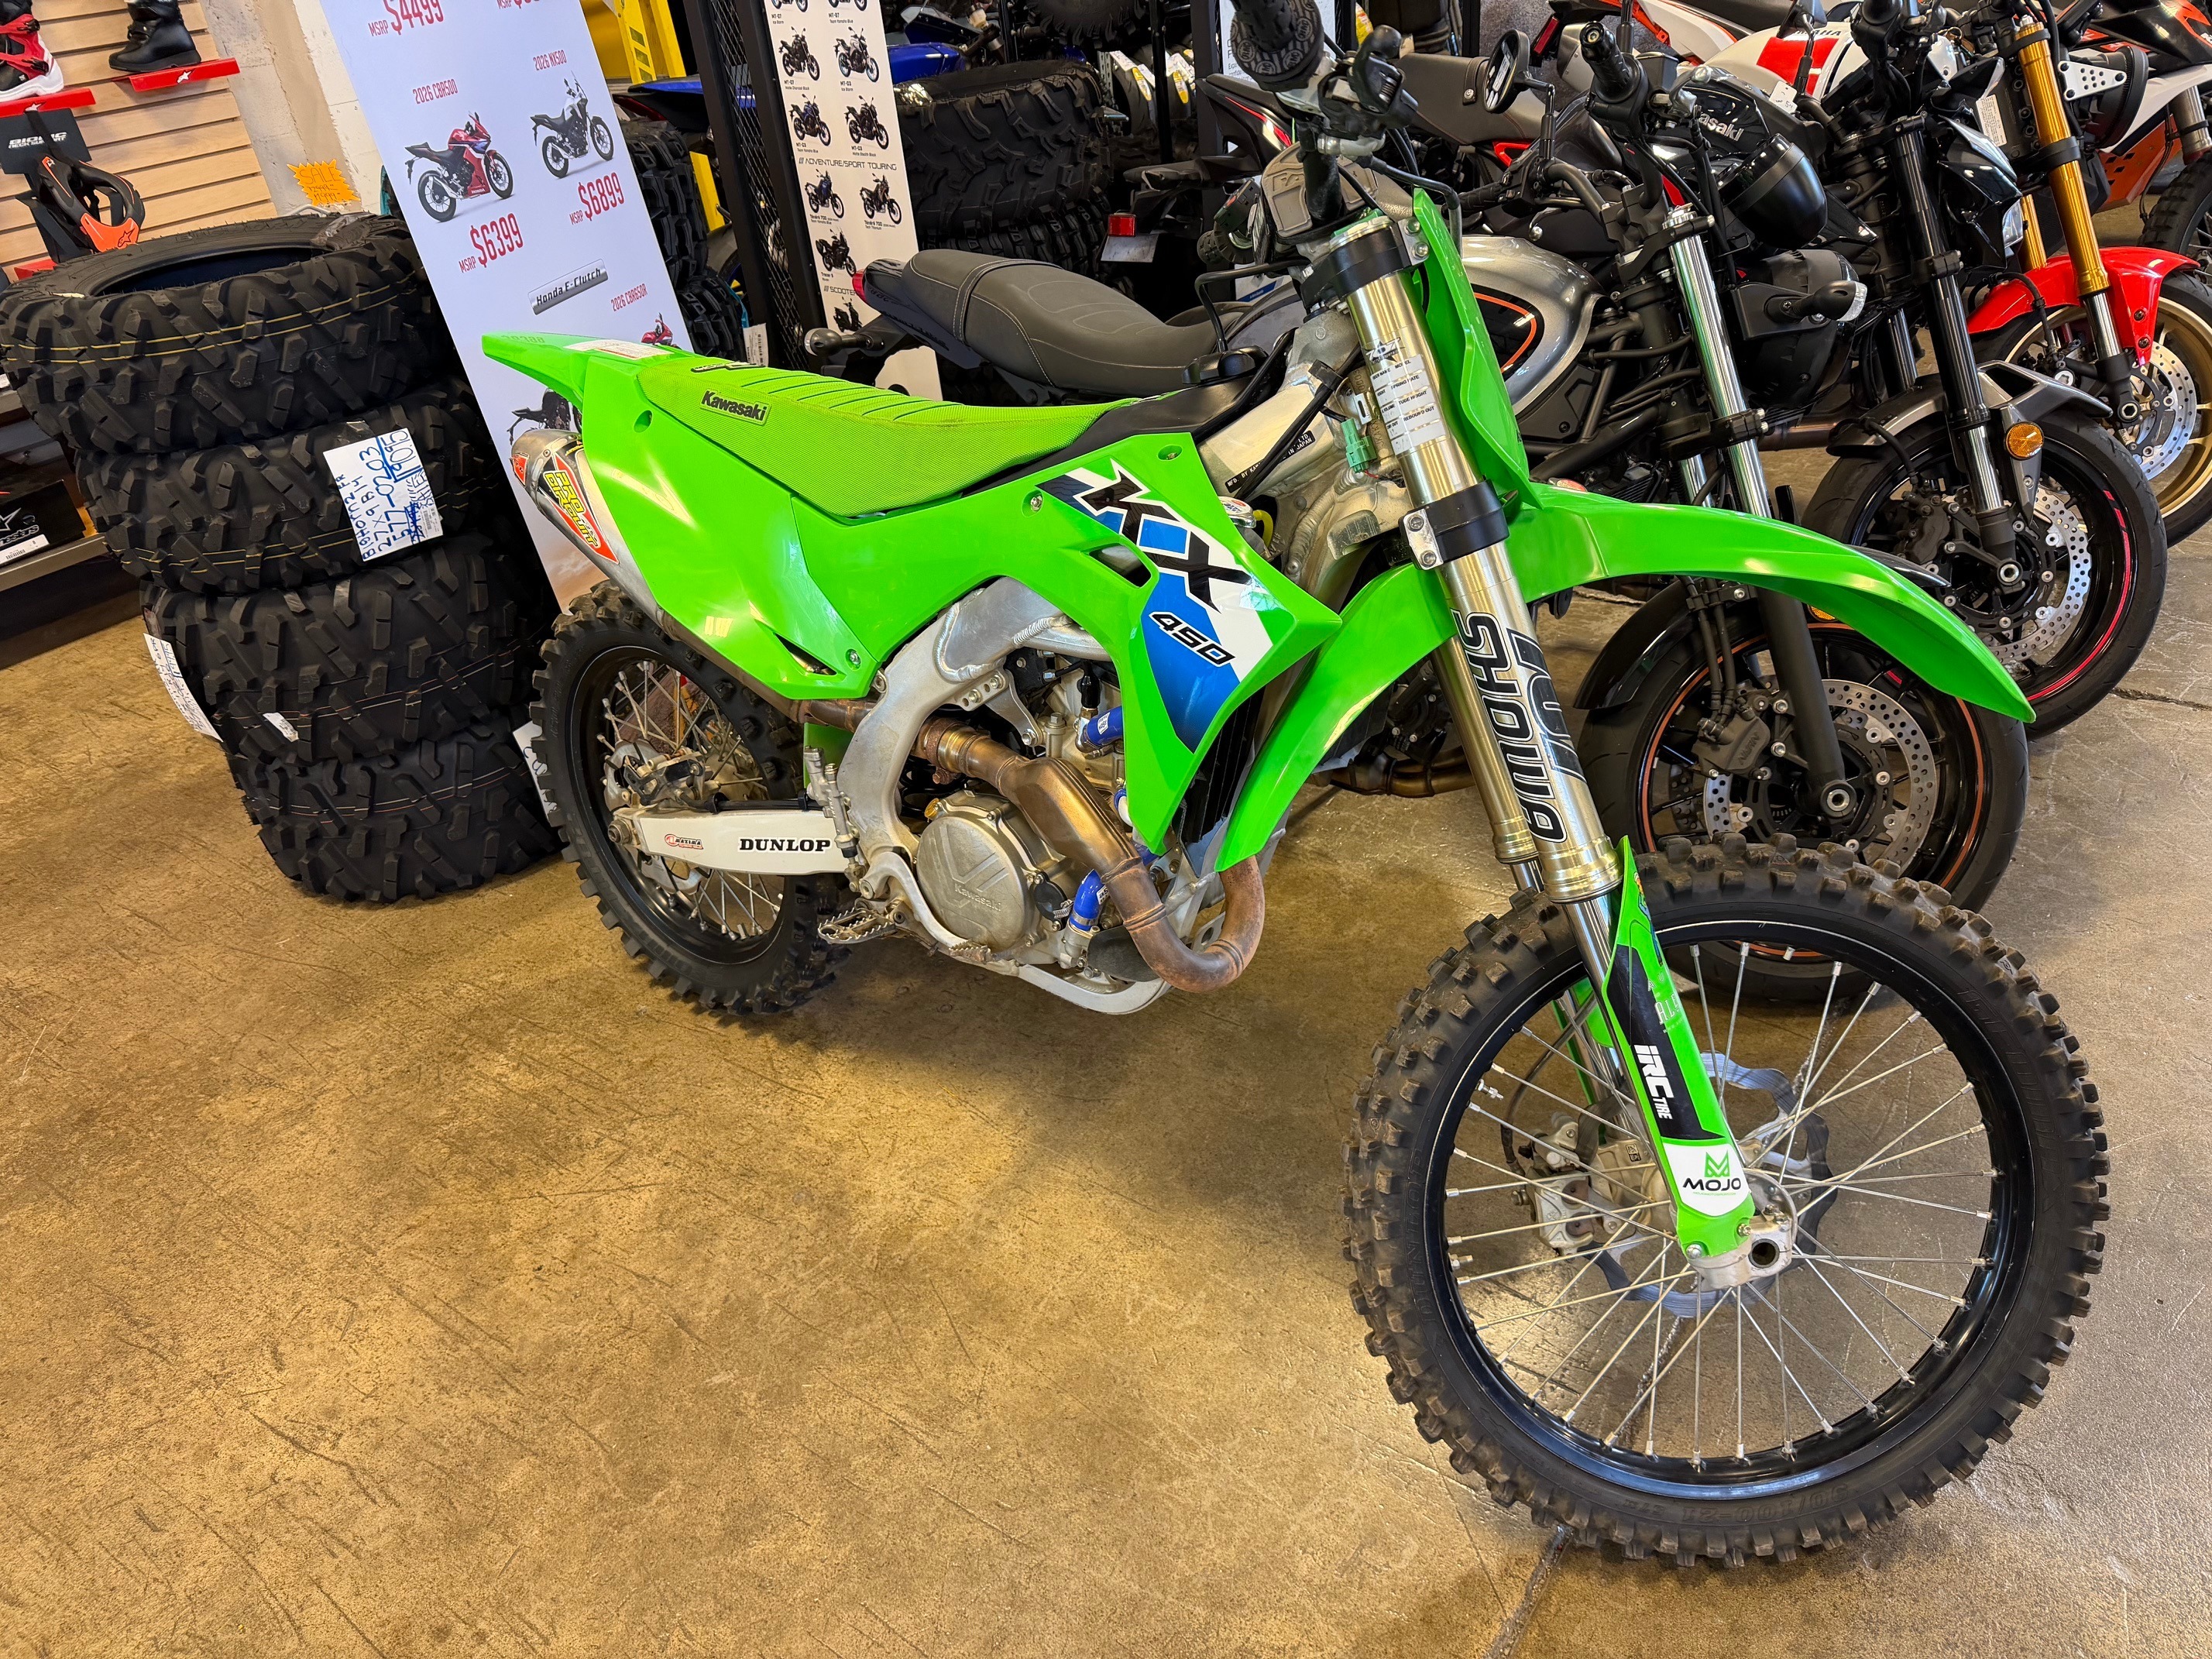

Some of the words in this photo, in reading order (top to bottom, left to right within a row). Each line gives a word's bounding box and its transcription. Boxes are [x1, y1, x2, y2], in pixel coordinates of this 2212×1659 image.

[368, 19, 389, 36] MSRP
[383, 0, 444, 35] $4499
[533, 53, 550, 70] 2026
[548, 49, 567, 67] NX500
[412, 84, 434, 105] 2026
[432, 78, 459, 99] CBR500
[1698, 112, 1744, 142] asaki
[299, 167, 342, 184] SALE
[805, 157, 865, 169] ADVENTURE/SPORT
[867, 162, 897, 171] TOURING
[569, 210, 584, 225] MSRP
[578, 172, 625, 222] $6899
[459, 255, 476, 273] MSRP
[469, 212, 524, 268] $6399
[535, 284, 564, 307] Honda
[563, 267, 602, 294] E-Clutch
[610, 294, 627, 311] 2026
[701, 390, 768, 421] Kawasaki
[1297, 438, 1313, 450] JAPAN
[555, 472, 586, 514] PRO
[544, 472, 599, 547] CIRCUIT
[1150, 613, 1236, 665] 450
[1451, 608, 1568, 843] SHOWA
[740, 838, 831, 852] DUNLOP
[954, 883, 1001, 912] Kawasaki
[1653, 1097, 1673, 1120] TIRE
[1682, 1177, 1742, 1191] MOJO
